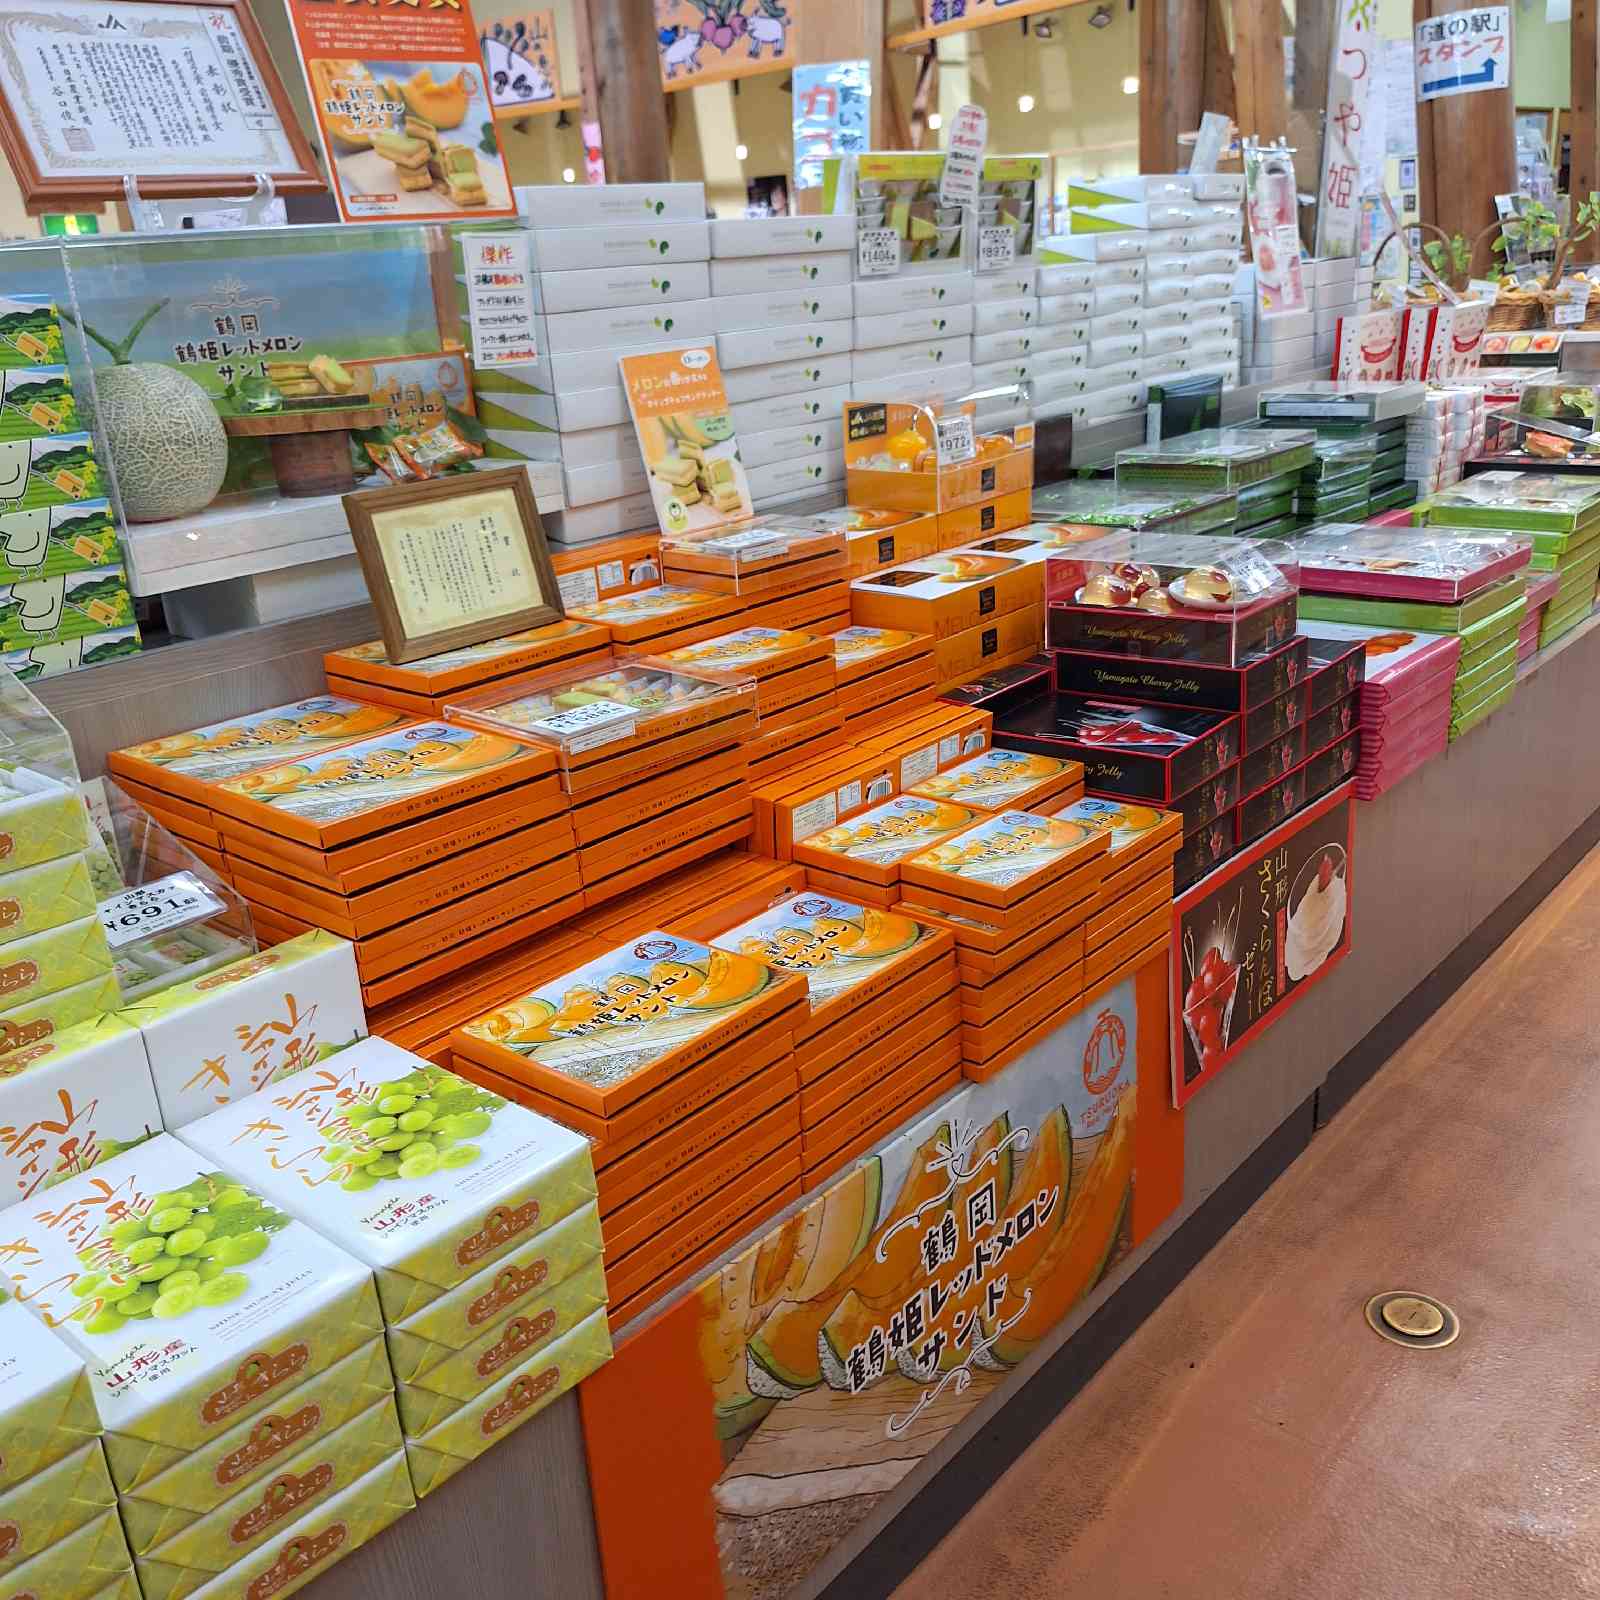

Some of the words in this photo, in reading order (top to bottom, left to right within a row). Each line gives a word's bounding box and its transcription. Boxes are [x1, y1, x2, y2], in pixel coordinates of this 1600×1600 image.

[213, 313, 260, 336] 鶴岡
[1274, 847, 1289, 904] 山形
[103, 898, 184, 932] ¥691
[373, 1193, 436, 1232] 山形産
[922, 1181, 996, 1273] 鶴岡
[847, 1186, 1059, 1391] 鶴姫レッドメロン
[917, 1275, 1008, 1375] サンド
[106, 1338, 189, 1389] 山形産
